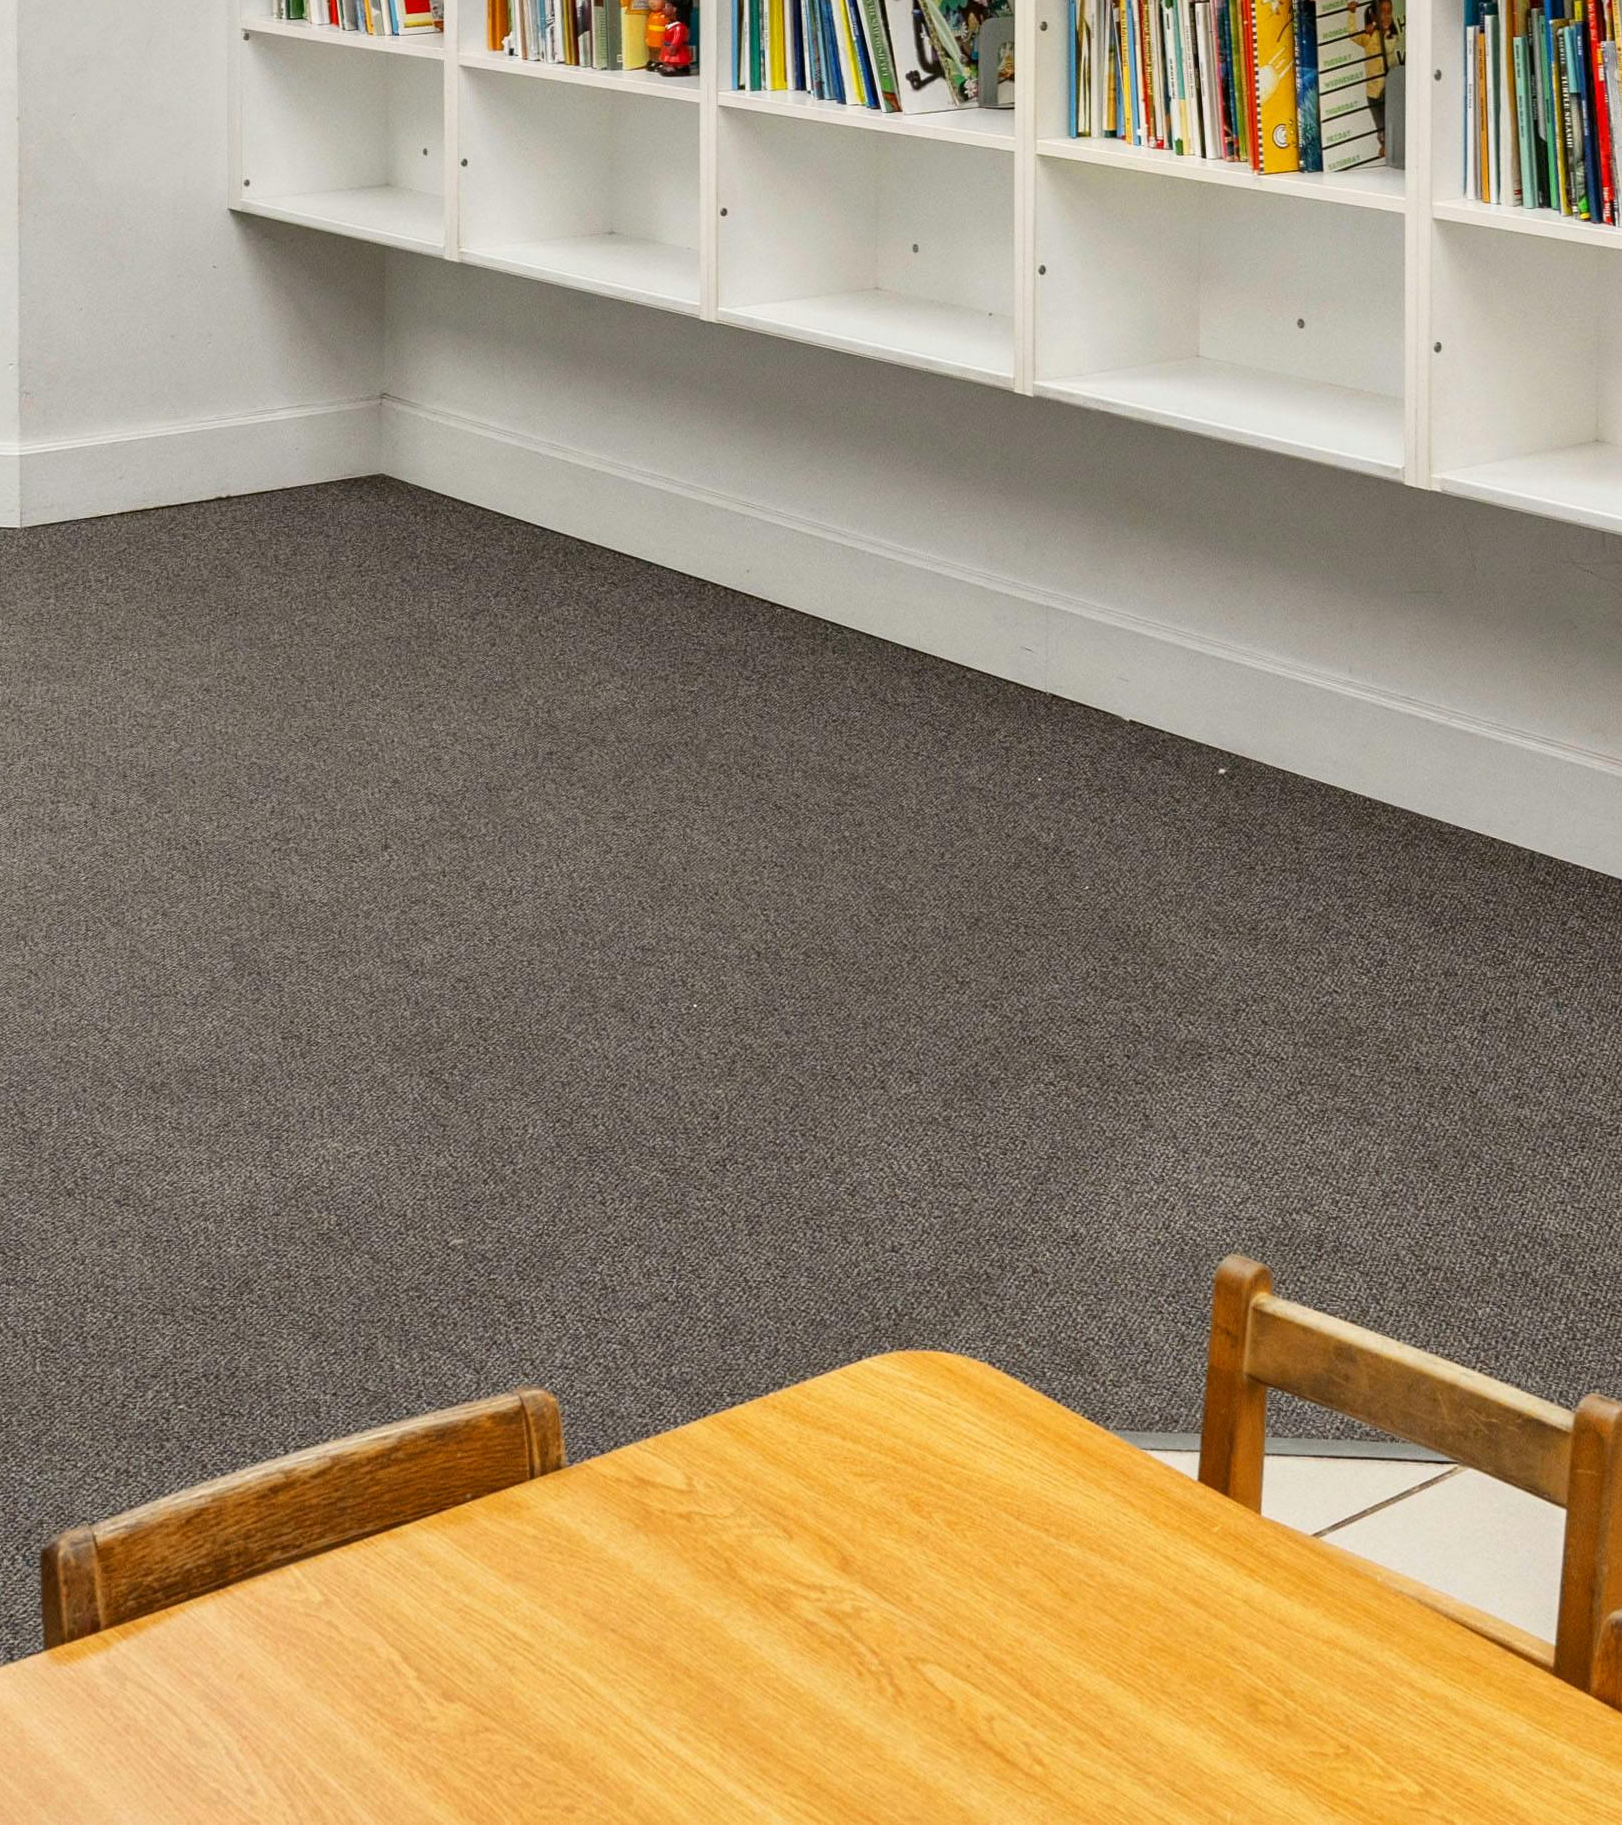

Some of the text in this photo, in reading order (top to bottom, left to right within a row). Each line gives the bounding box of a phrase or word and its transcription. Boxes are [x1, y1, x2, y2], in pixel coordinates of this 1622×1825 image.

[1321, 26, 1349, 40] MONDA
[1323, 54, 1352, 67] TUESDAY
[1323, 71, 1364, 88] WEDNESDAY
[1325, 100, 1359, 116] THURSDAY
[1561, 76, 1573, 149] TURTLE SPLASH!
[1327, 130, 1351, 143] FRIDAY
[1327, 155, 1362, 171] SATURDAY
